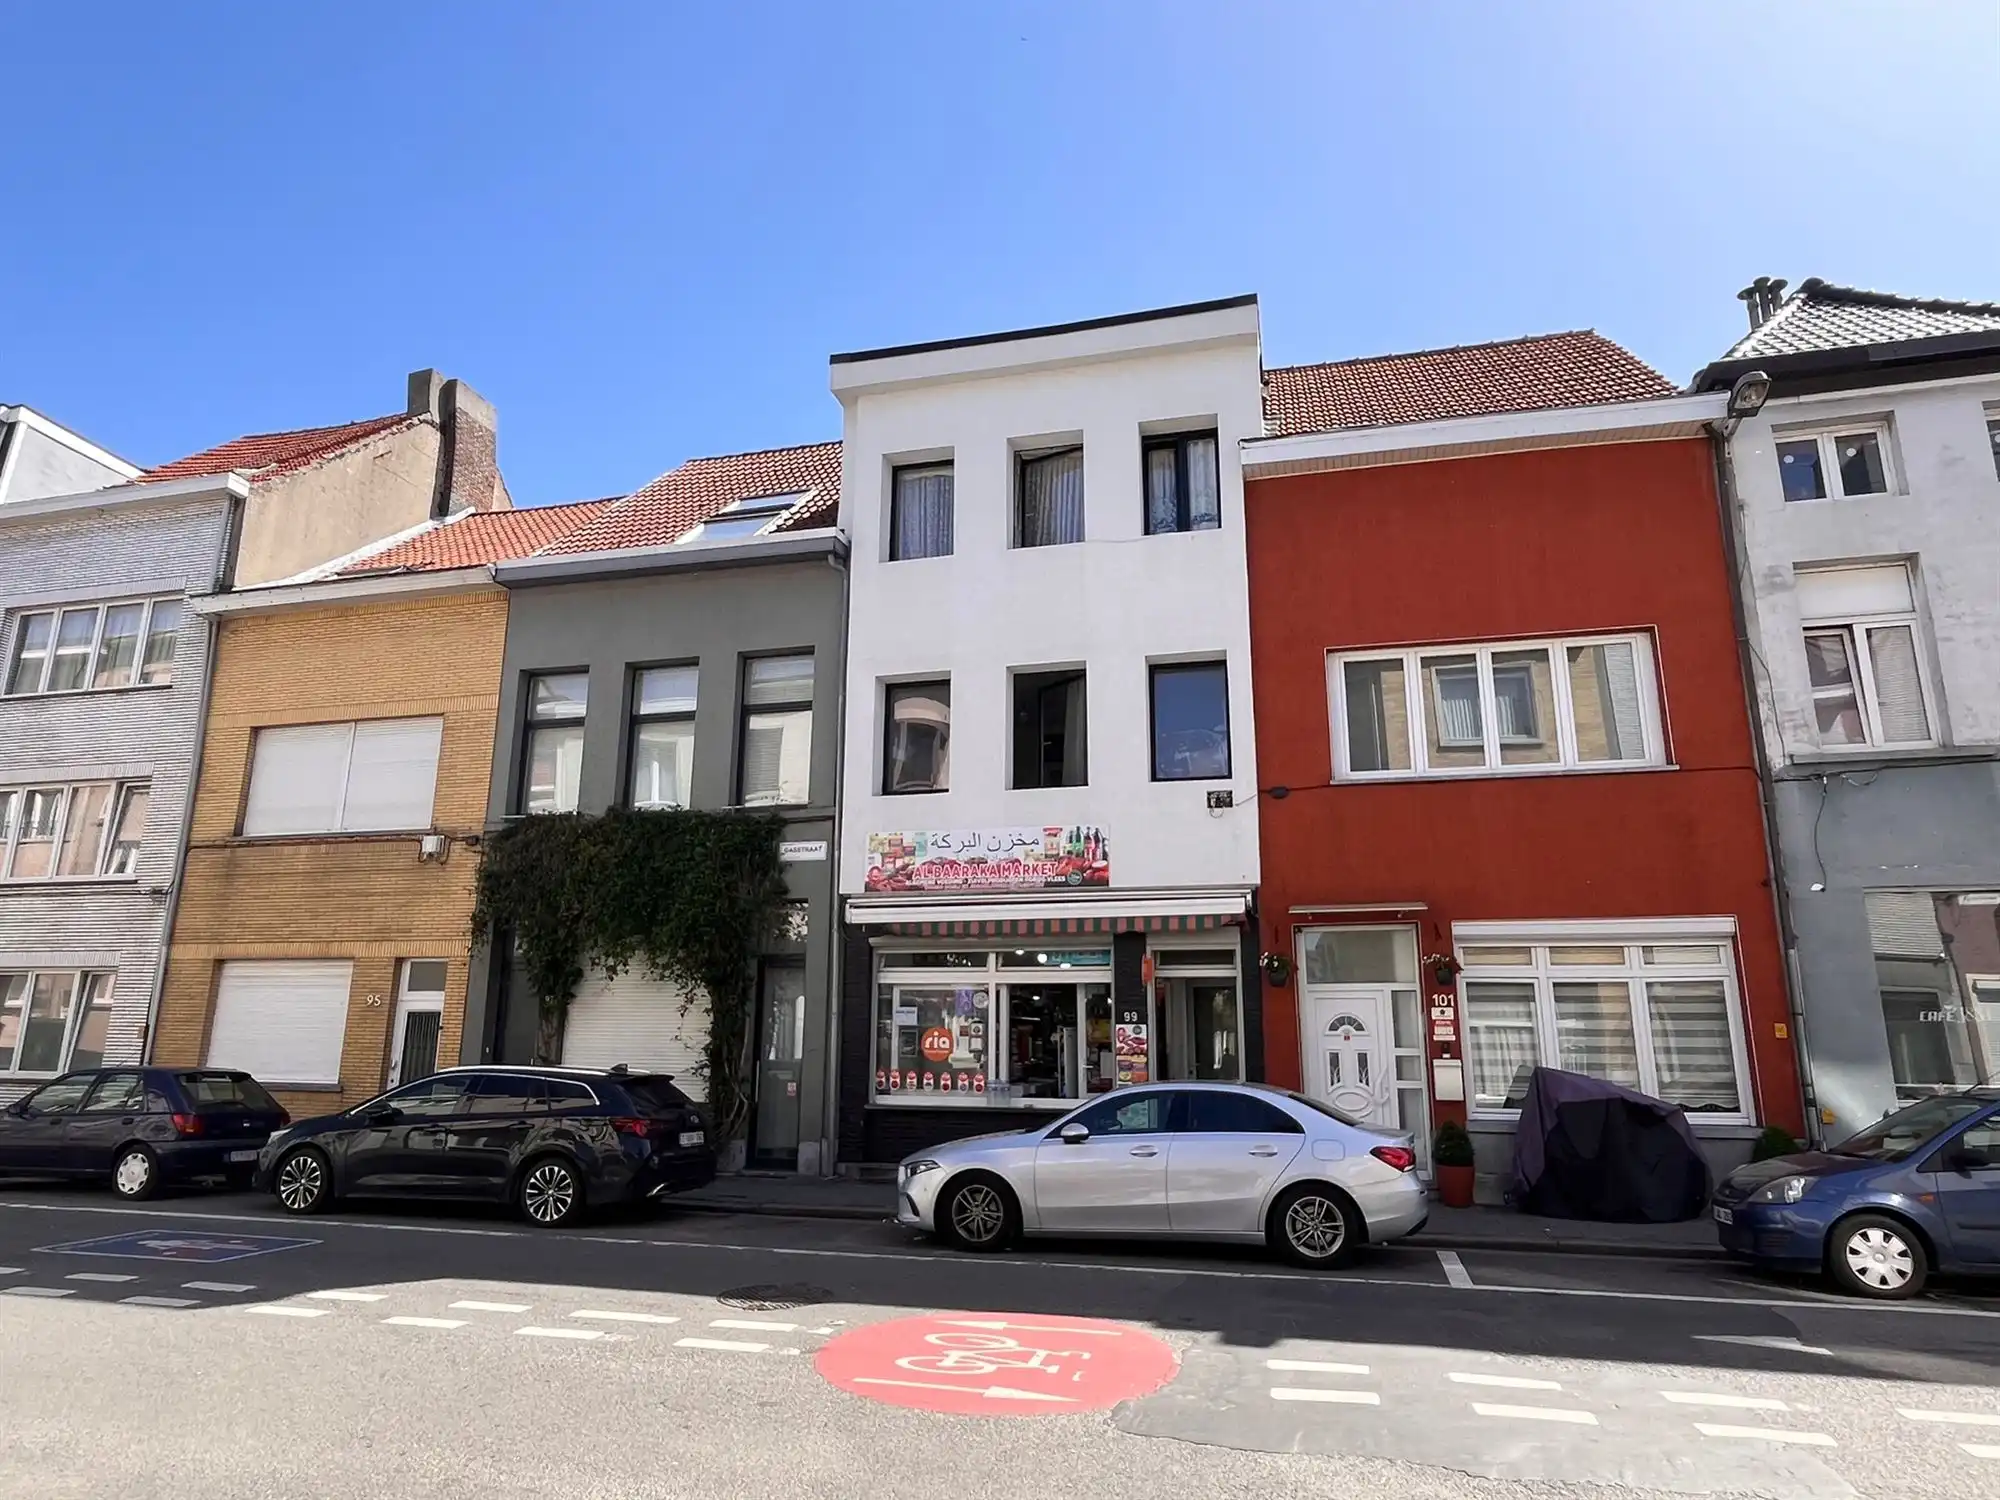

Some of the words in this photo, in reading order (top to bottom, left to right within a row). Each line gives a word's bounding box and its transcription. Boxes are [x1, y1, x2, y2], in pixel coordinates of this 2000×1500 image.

[930, 832, 981, 853] البركة
[986, 833, 1040, 853] مخزن
[1001, 862, 1058, 876] MARKET
[366, 994, 381, 1006] 95
[1432, 994, 1454, 1006] 101
[1123, 1011, 1138, 1022] 99
[924, 1030, 950, 1049] ria
